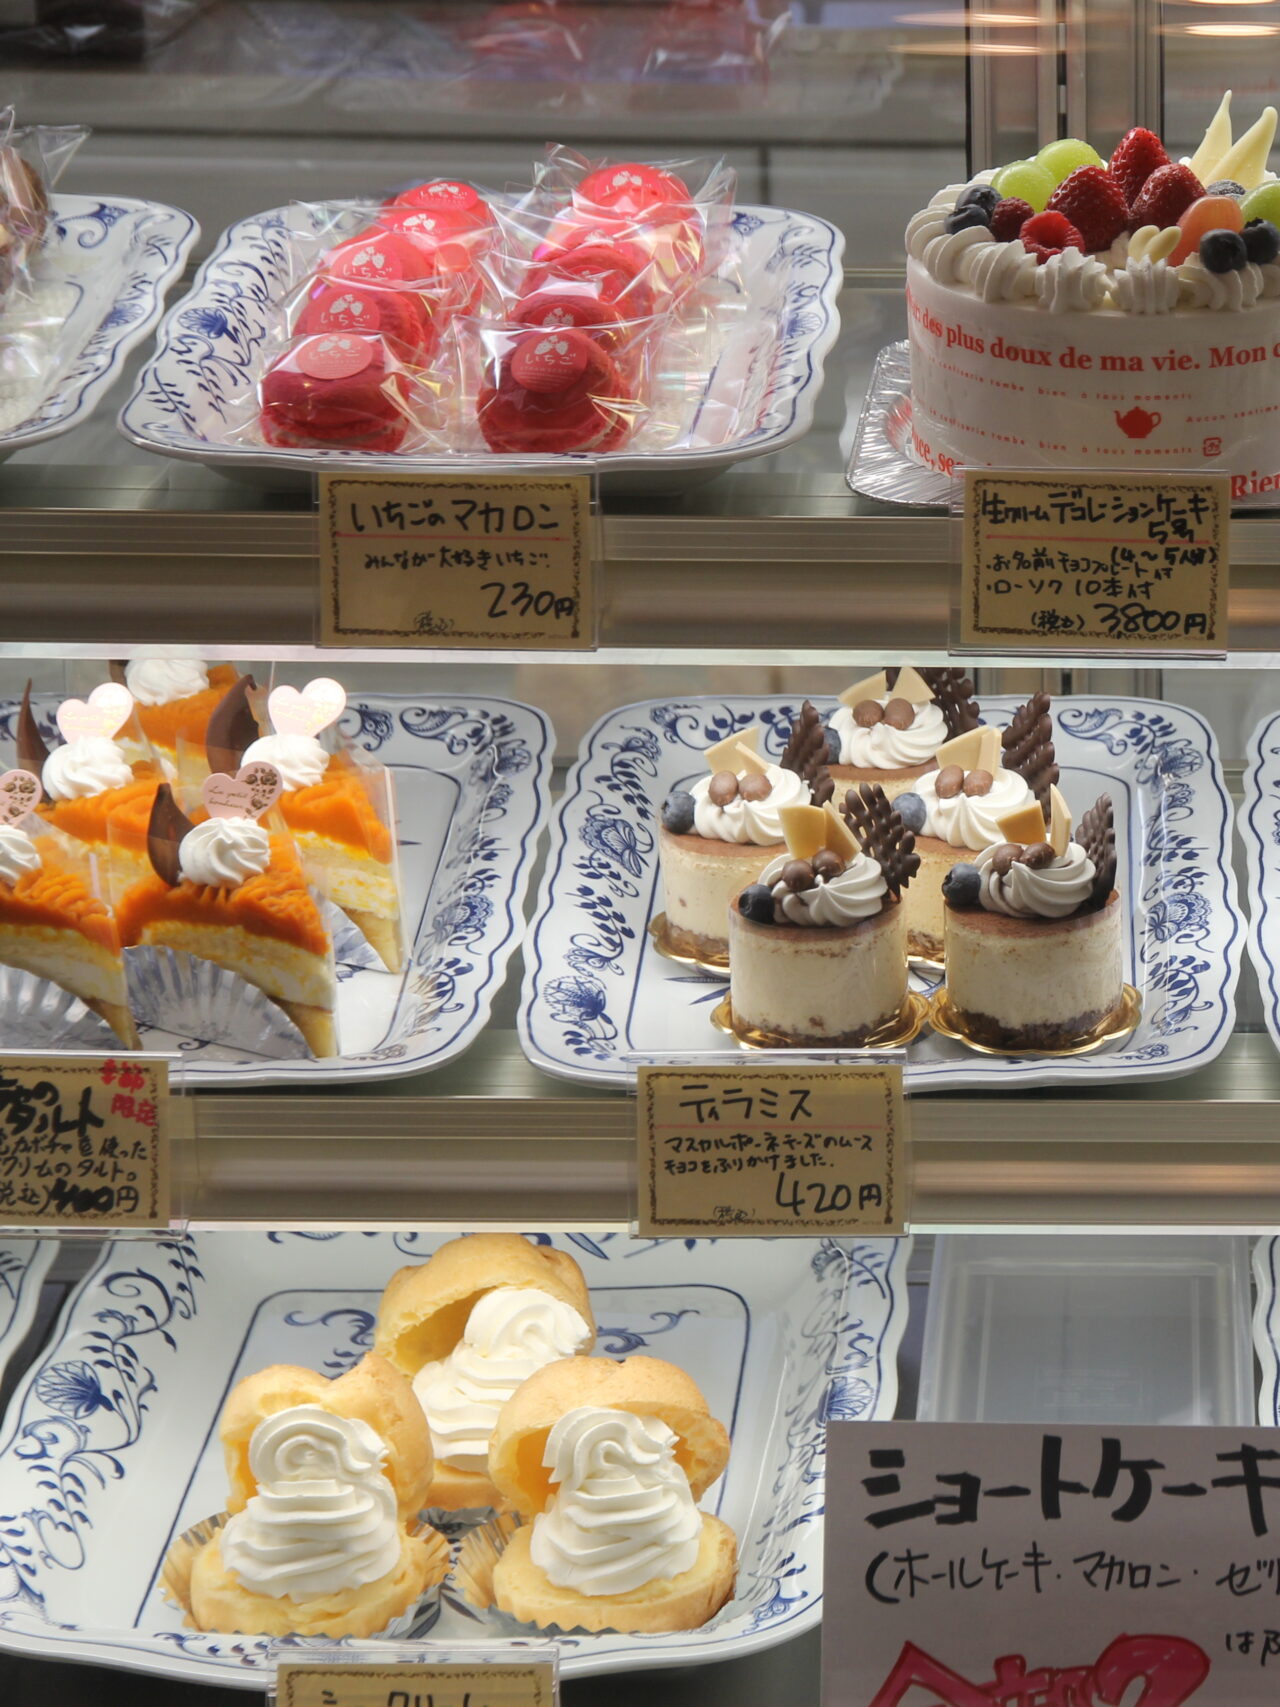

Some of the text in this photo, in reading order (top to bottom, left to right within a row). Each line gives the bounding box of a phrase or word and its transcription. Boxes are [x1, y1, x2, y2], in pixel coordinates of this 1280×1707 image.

[342, 264, 393, 281] いちご
[320, 312, 371, 327] いちご
[922, 306, 943, 338] des
[946, 325, 985, 354] plus
[990, 336, 1053, 367] doux
[1058, 346, 1093, 370] de
[1098, 353, 1144, 373] ma
[1151, 350, 1200, 372] vie.
[1208, 345, 1267, 369] Mon
[525, 353, 577, 366] いちご
[1037, 386, 1067, 398] bien
[1038, 440, 1068, 451] bien
[350, 497, 560, 536] いちごのマカロン
[981, 489, 1212, 525] 生クリームデコレーションケーキ
[480, 581, 576, 620] 230円
[678, 1083, 813, 1123] ティラミス
[664, 1132, 874, 1153] マスカルポーネチーズのムース
[775, 1171, 883, 1217] 420円
